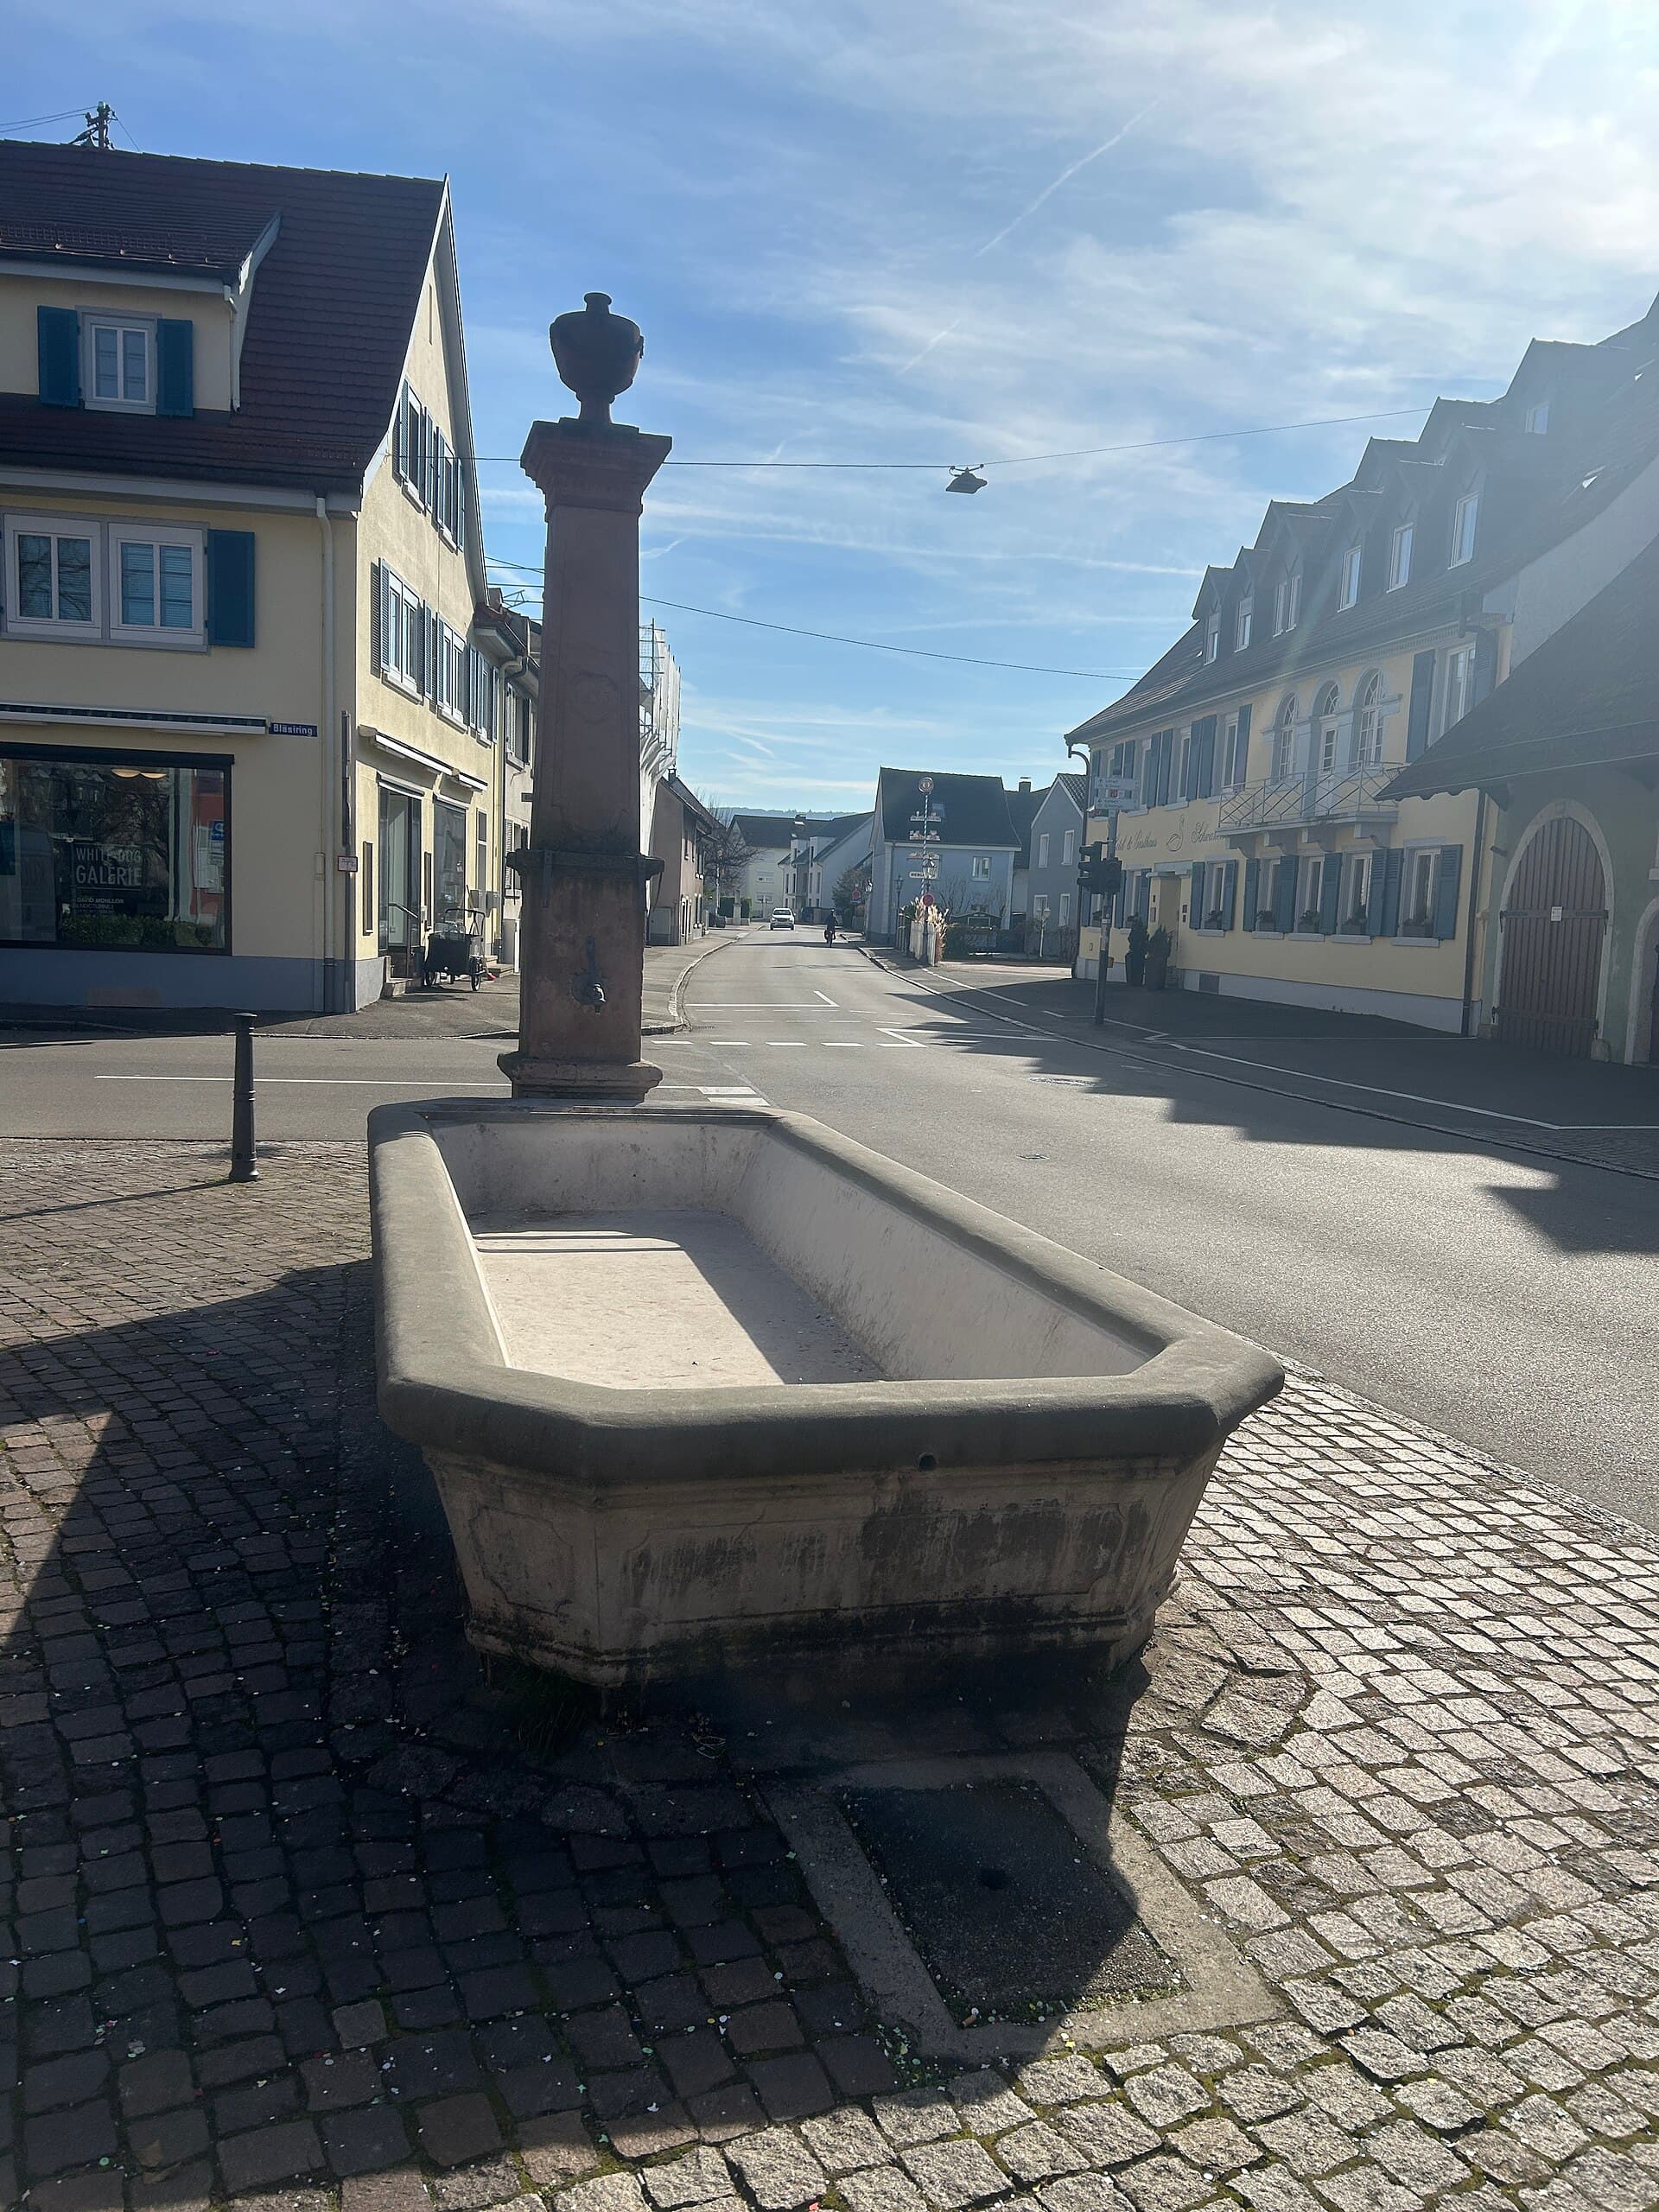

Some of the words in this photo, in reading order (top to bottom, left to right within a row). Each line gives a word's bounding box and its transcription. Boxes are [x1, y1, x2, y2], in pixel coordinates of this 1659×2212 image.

[273, 723, 313, 736] Bläsiring
[76, 848, 113, 862] WHITE
[118, 849, 142, 864] DOG
[76, 865, 142, 886] GALERIE
